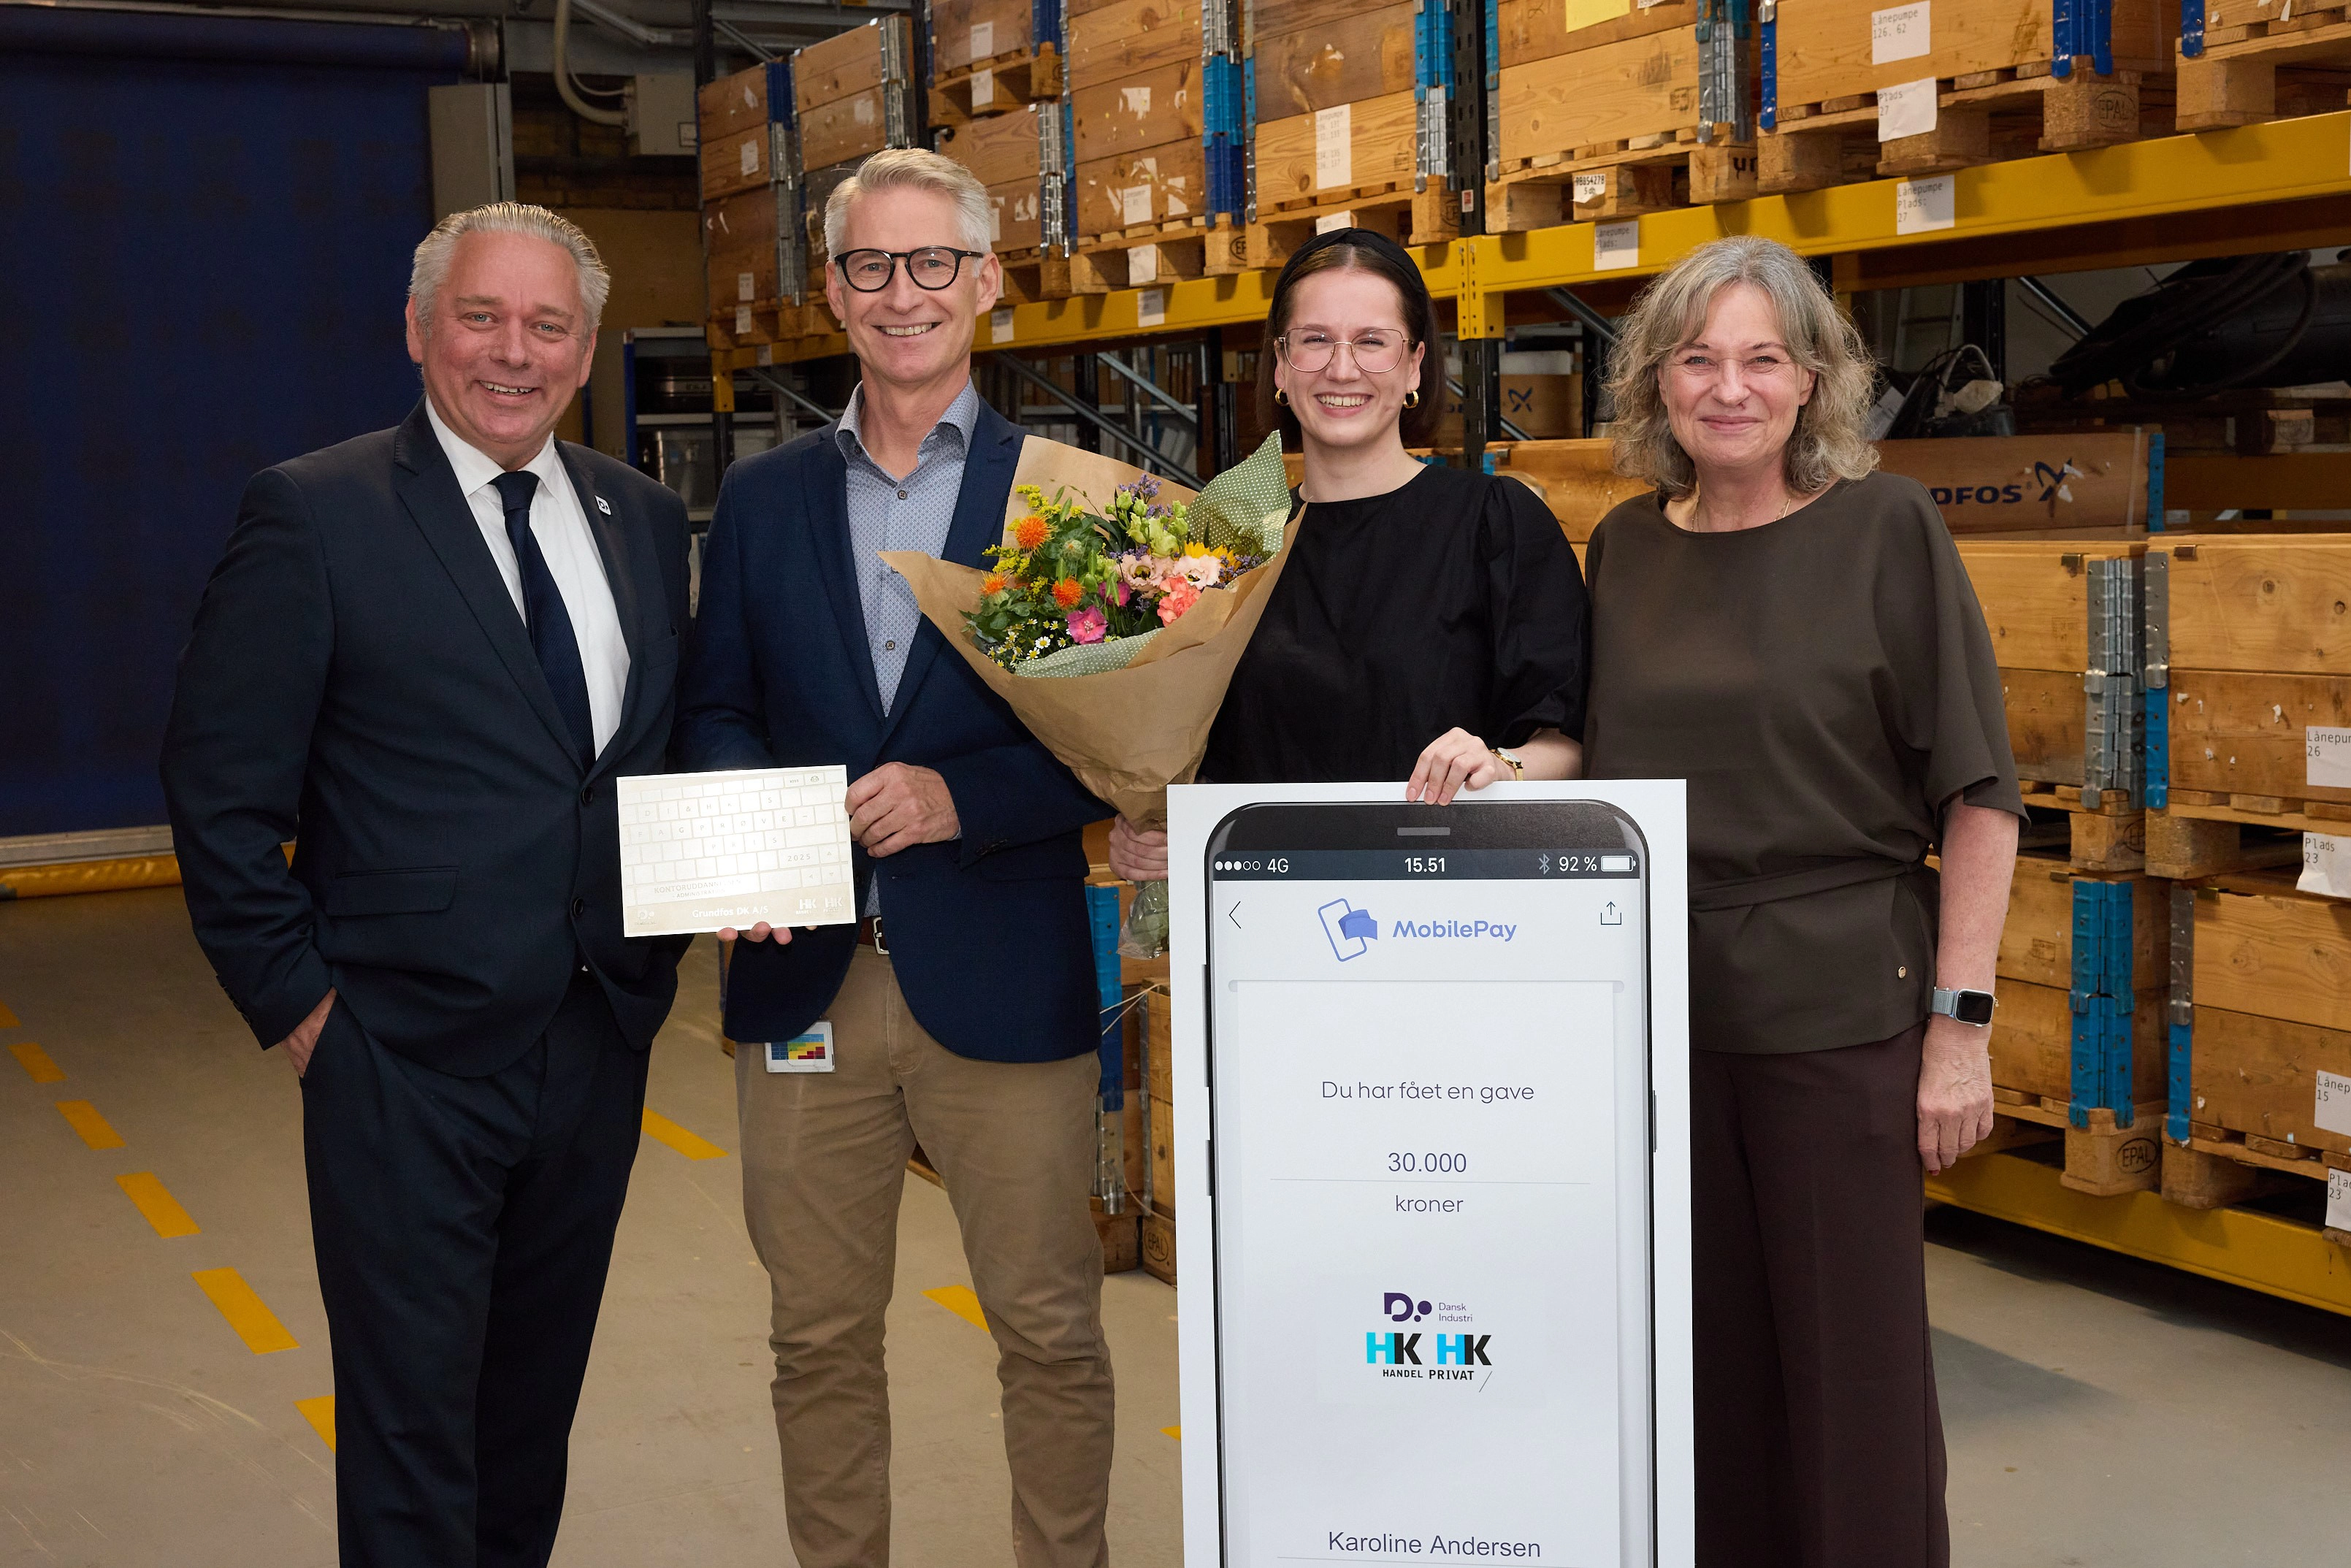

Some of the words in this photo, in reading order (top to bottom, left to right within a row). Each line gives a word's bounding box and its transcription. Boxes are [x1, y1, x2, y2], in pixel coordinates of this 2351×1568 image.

[1873, 9, 1918, 26] Lånepumpe
[1897, 23, 1906, 34] 62
[1878, 91, 1903, 102] Plads
[1879, 105, 1889, 116] 27
[1897, 183, 1943, 197] Lånepumpe
[1898, 212, 1908, 223] 27
[2307, 746, 2320, 757] 26
[2305, 838, 2335, 852] Plads
[787, 853, 811, 862] 2025
[1559, 856, 1579, 872] 92
[1583, 856, 1598, 873] %
[2305, 852, 2318, 863] 23
[1267, 858, 1289, 873] 4G
[1404, 857, 1446, 873] 15.51
[799, 898, 817, 910] HK
[824, 897, 844, 909] HK
[692, 908, 734, 918] Grundfos
[736, 906, 749, 916] DK
[752, 905, 769, 915] A/S
[1393, 918, 1517, 942] MobilePay
[1322, 1080, 1353, 1099] Du
[1358, 1080, 1394, 1099] har
[1399, 1080, 1442, 1100] fået
[1447, 1086, 1474, 1100] en
[1480, 1087, 1535, 1104] gave
[2317, 1090, 2328, 1101] 15
[1388, 1152, 1467, 1173] 30.000
[2122, 1145, 2152, 1168] EPAL
[2330, 1173, 2351, 1188] Pla
[2329, 1188, 2341, 1200] 23
[1395, 1193, 1464, 1213] kroner
[1147, 1231, 1166, 1256] EPAL
[1439, 1302, 1467, 1312] Dansk
[1439, 1313, 1473, 1323] Industri
[1366, 1332, 1423, 1365] HK
[1437, 1334, 1492, 1366] HK
[1383, 1369, 1423, 1378] HANDEL
[1429, 1369, 1475, 1380] PRIVAT
[1329, 1531, 1422, 1554] Karoline
[1429, 1534, 1541, 1558] Andersen
